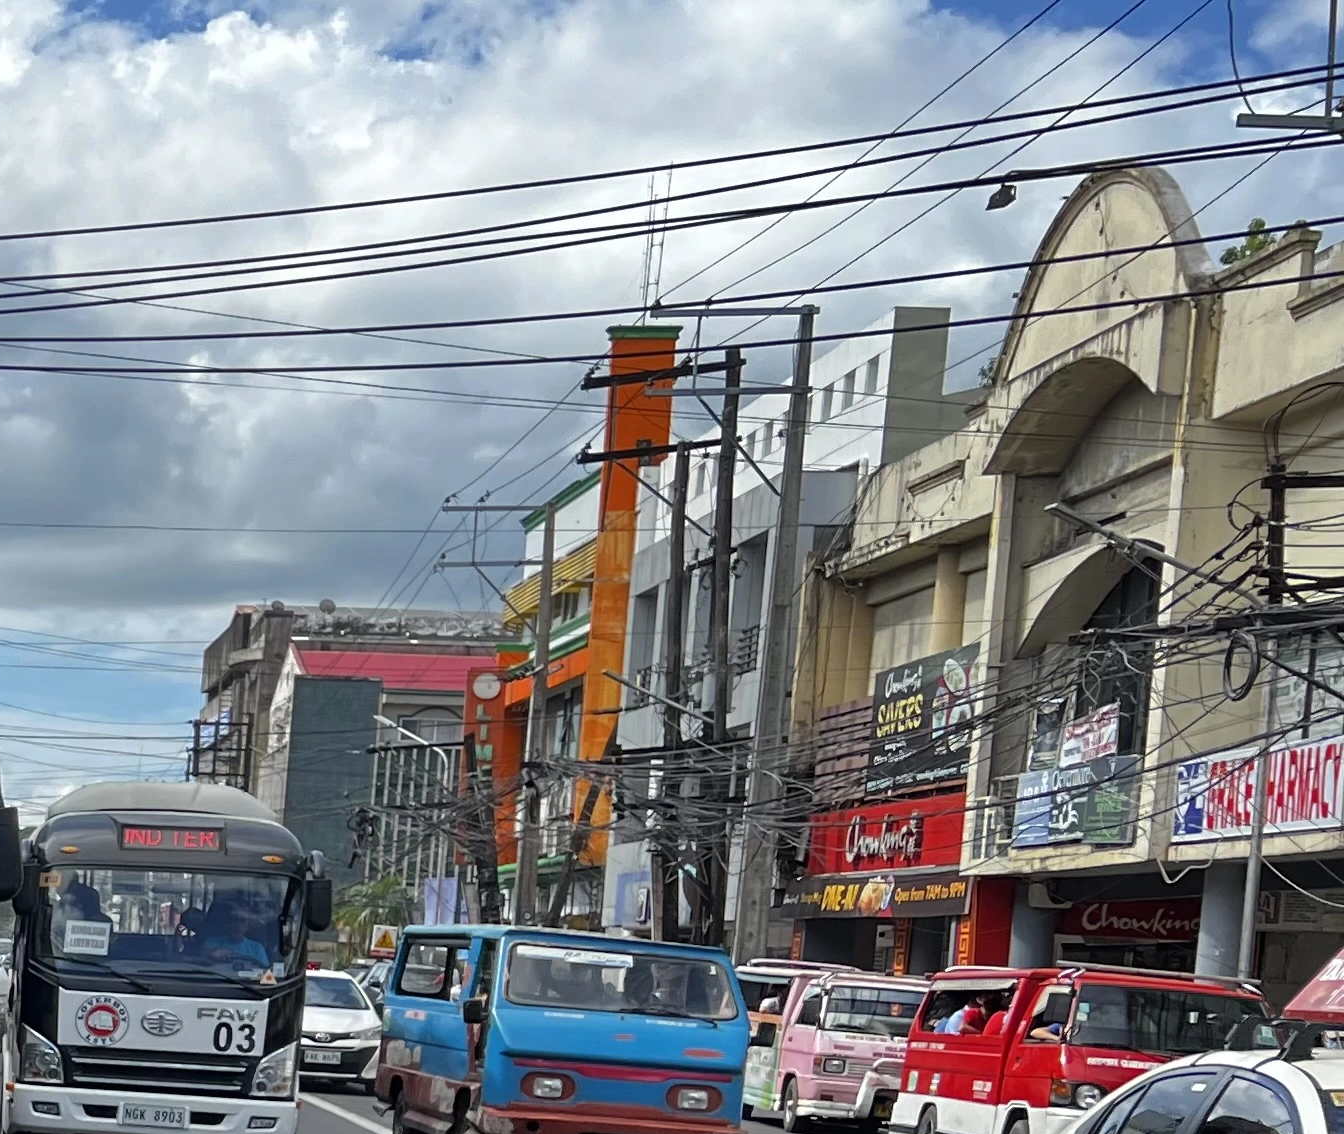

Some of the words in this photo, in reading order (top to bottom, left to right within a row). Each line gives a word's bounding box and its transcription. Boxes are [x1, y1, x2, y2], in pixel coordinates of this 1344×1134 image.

[196, 1007, 260, 1022] FAW
[212, 1021, 256, 1054] 03
[124, 1107, 146, 1121] NGK
[153, 1109, 183, 1124] 8903
